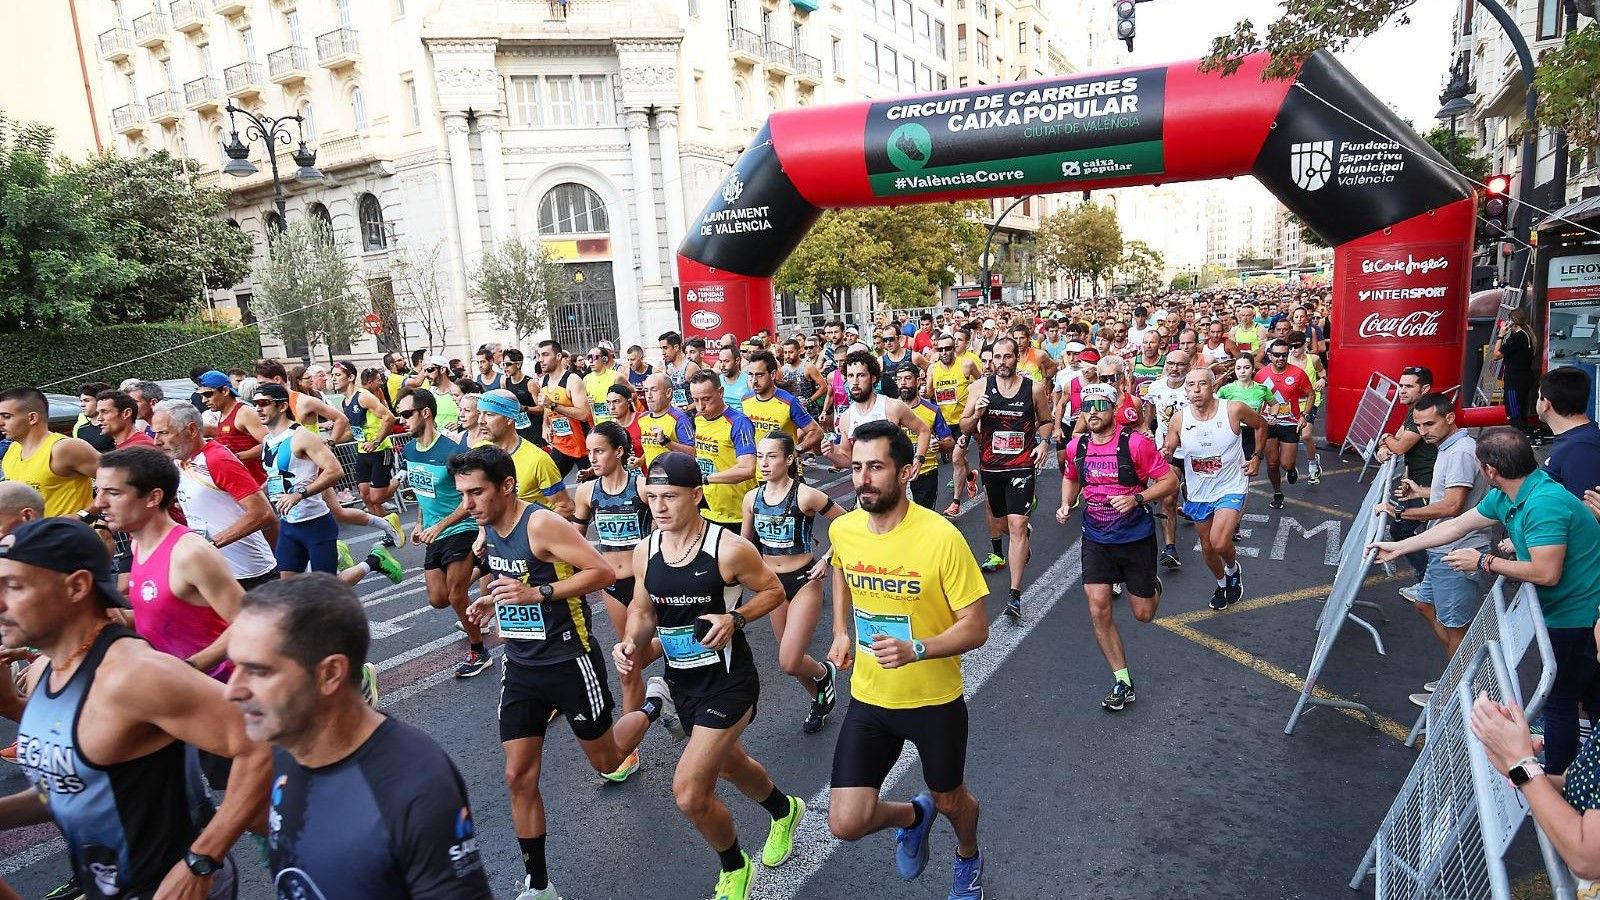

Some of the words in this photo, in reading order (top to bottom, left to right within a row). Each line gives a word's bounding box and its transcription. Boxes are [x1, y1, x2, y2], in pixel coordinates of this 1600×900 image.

[887, 98, 970, 120] CIRCUIT
[974, 94, 1003, 111] DE
[1008, 77, 1138, 107] CARRERES
[1023, 125, 1062, 139] CIUTAT
[1064, 123, 1080, 134] DE
[1083, 116, 1140, 132] VALÈNCIA
[1083, 158, 1115, 168] caixa
[1338, 151, 1402, 165] Esportiva
[1083, 162, 1132, 175] popular
[1338, 161, 1405, 175] Municipal
[894, 169, 1025, 190] #ValènciaCorre
[1338, 174, 1395, 186] València
[702, 206, 769, 223] AJUNTAMENT
[701, 225, 712, 236] DE
[715, 219, 772, 234] VALÈNCIA
[1362, 259, 1375, 274] El
[1374, 259, 1406, 273] Corte
[1371, 286, 1447, 300] INTERSPORT
[1359, 309, 1444, 338] Coca-Cola
[408, 472, 433, 488] 2332
[598, 520, 637, 534] 2078
[757, 521, 791, 536] 2151
[846, 572, 921, 594] runners
[498, 605, 541, 622] 2296
